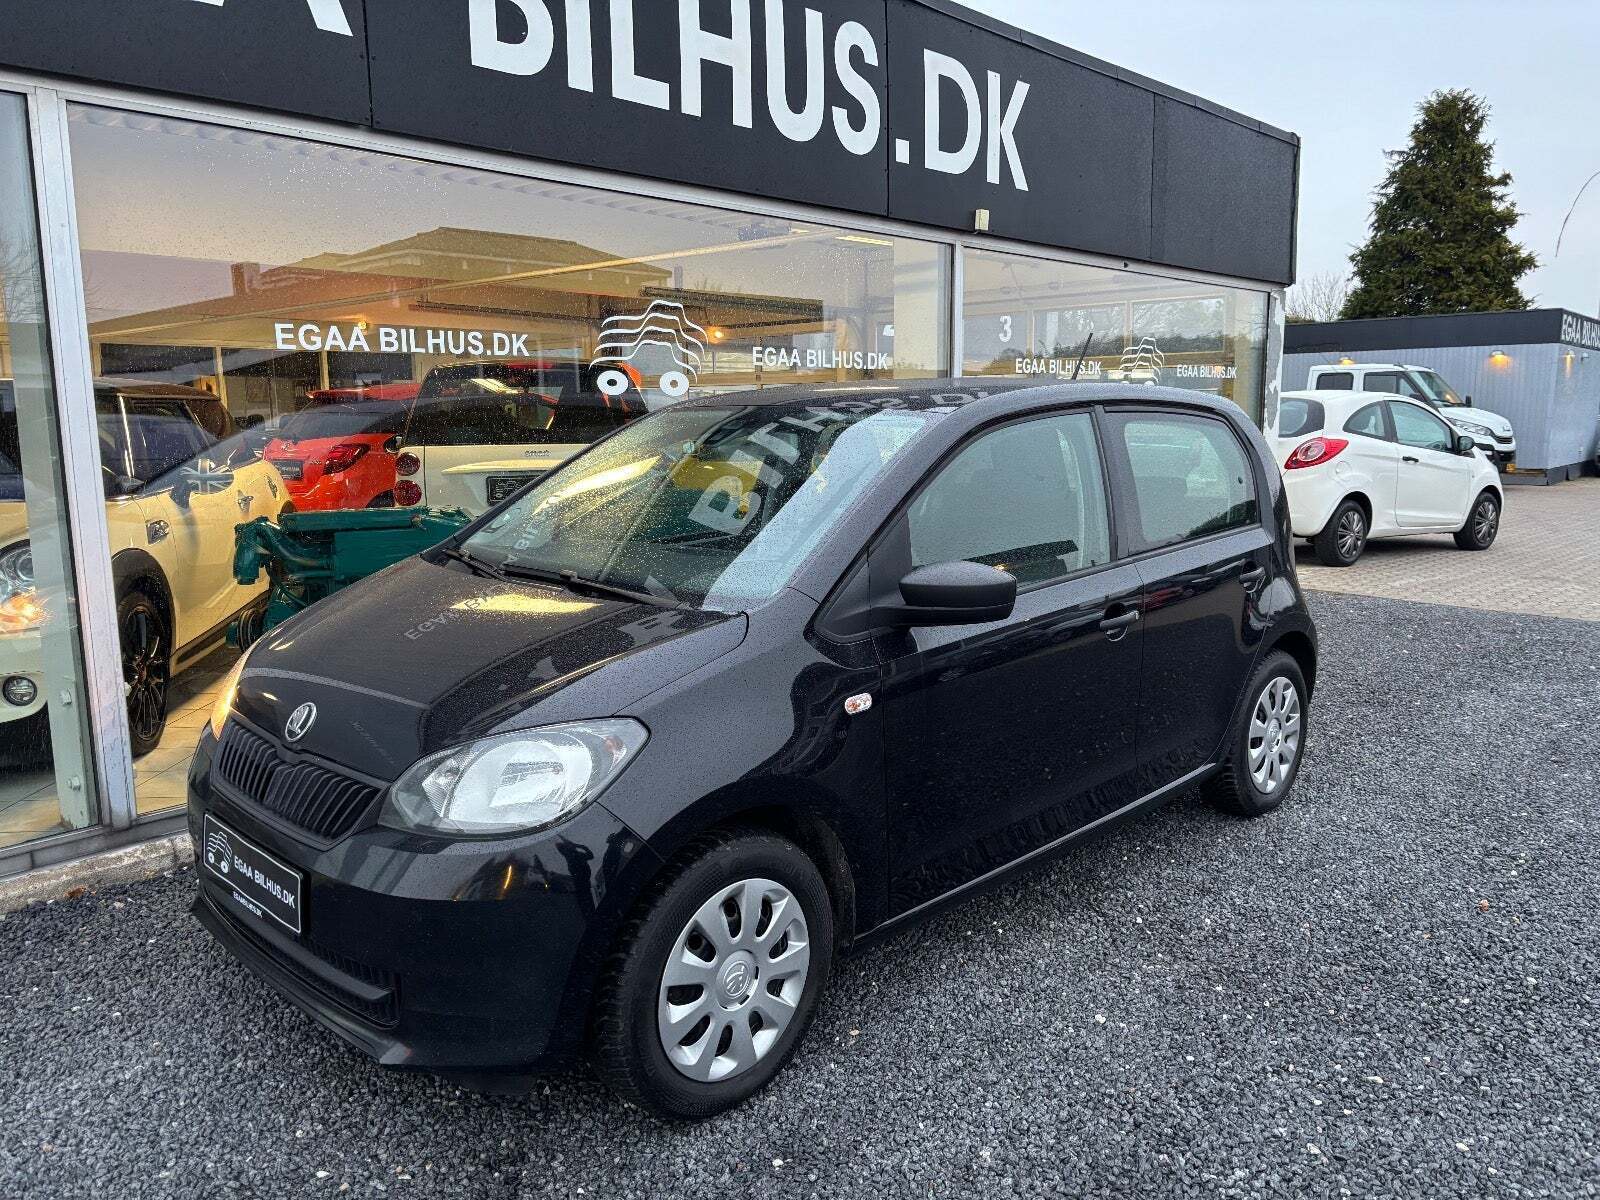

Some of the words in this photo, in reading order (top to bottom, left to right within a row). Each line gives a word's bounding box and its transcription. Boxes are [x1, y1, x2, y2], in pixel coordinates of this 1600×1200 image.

[273, 322, 371, 352] EGAA
[379, 326, 530, 357] BILHUS.DK
[999, 315, 1012, 342] 3
[752, 346, 801, 367] EGAA
[806, 348, 888, 370] BILHUS.DK
[1015, 357, 1046, 375] EGAA
[1176, 364, 1198, 379] EGAA
[1200, 365, 1237, 379] BILHUS.DK
[234, 855, 253, 880] EGAA
[254, 870, 295, 908] BILHUS.DK
